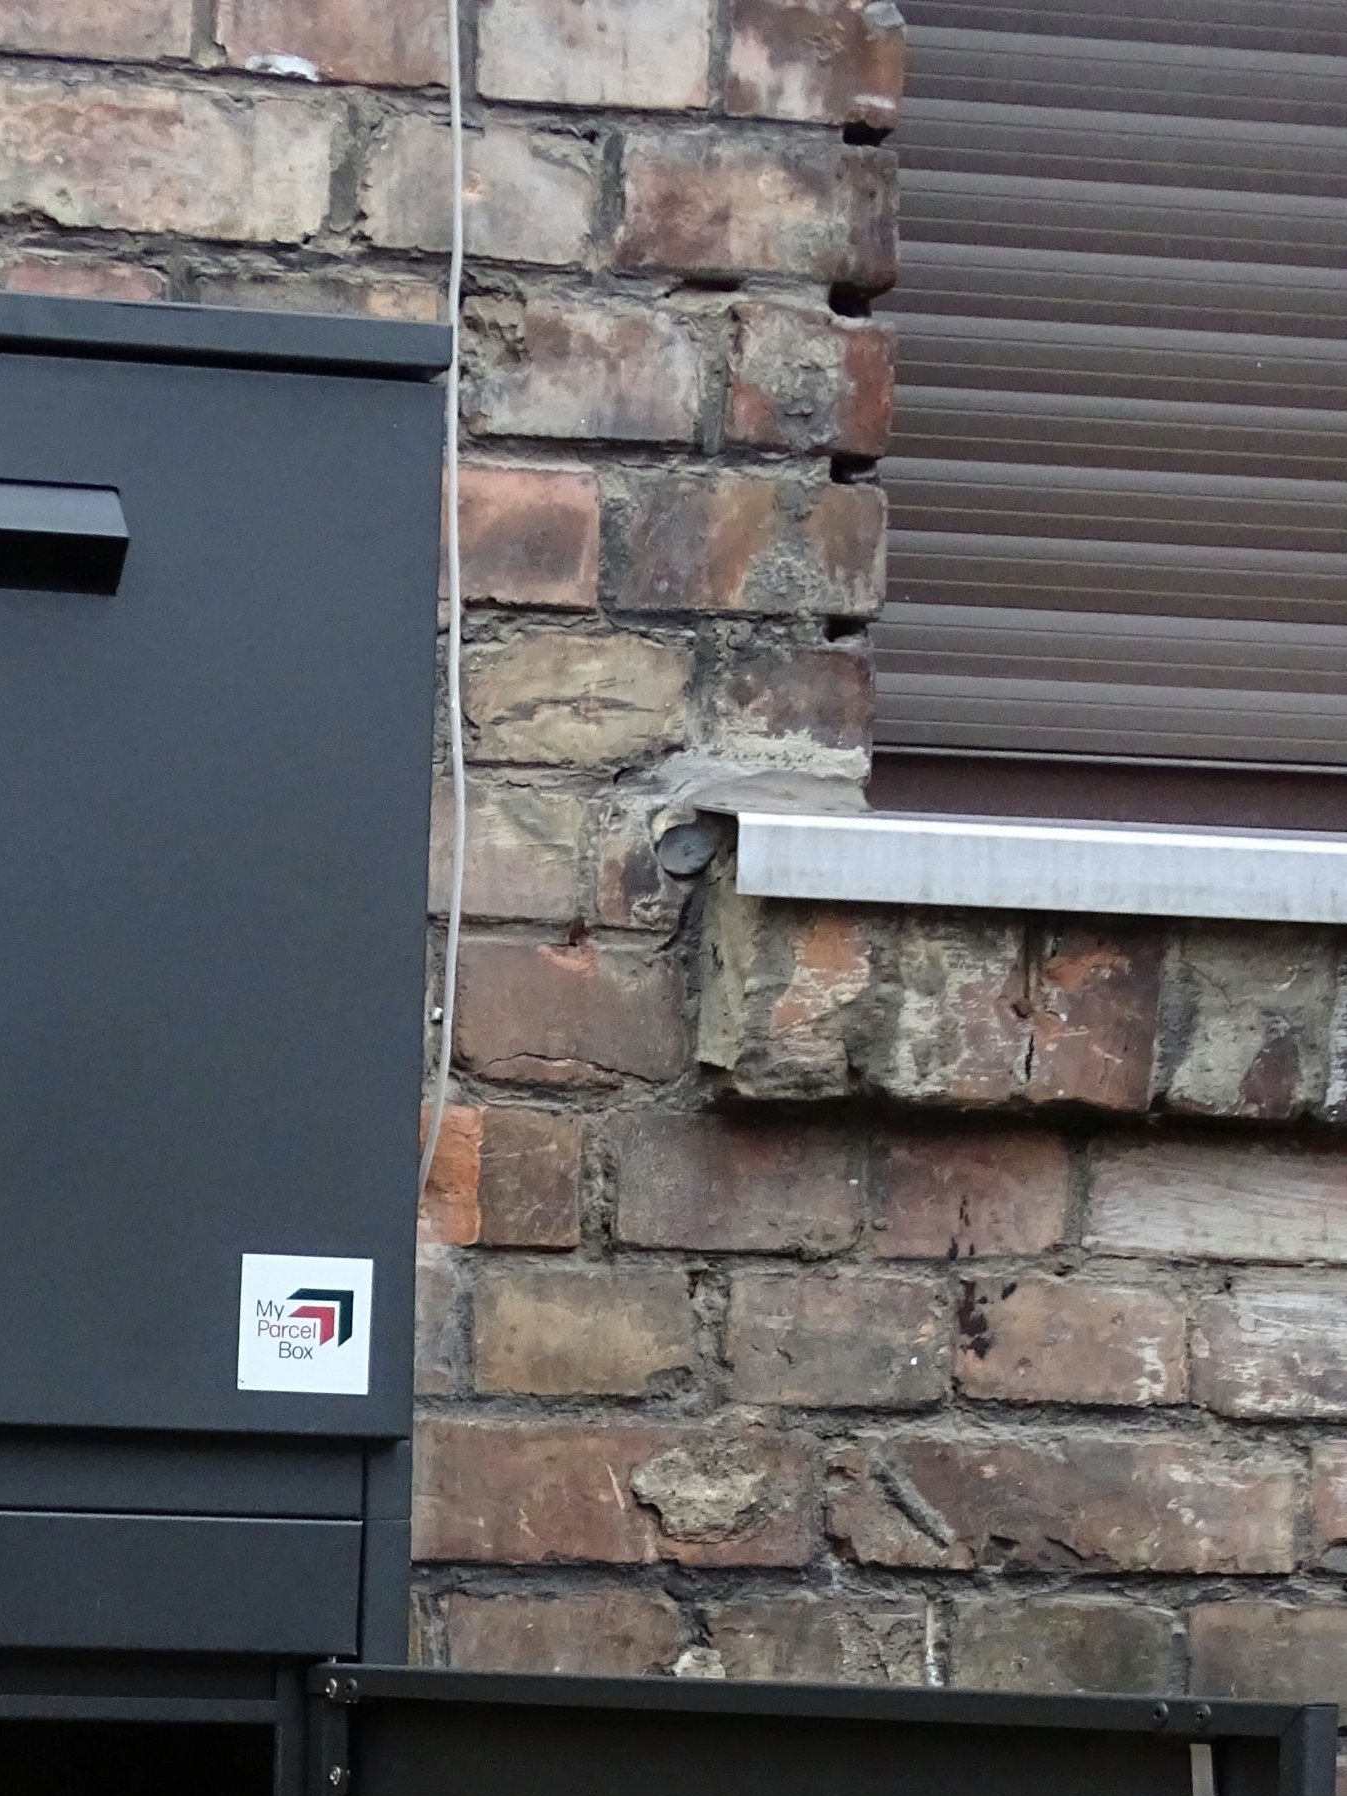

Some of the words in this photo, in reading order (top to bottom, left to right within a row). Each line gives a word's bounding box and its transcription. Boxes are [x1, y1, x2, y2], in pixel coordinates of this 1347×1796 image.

[256, 1299, 285, 1321] My
[257, 1320, 317, 1339] Parcel
[278, 1341, 313, 1360] Box
